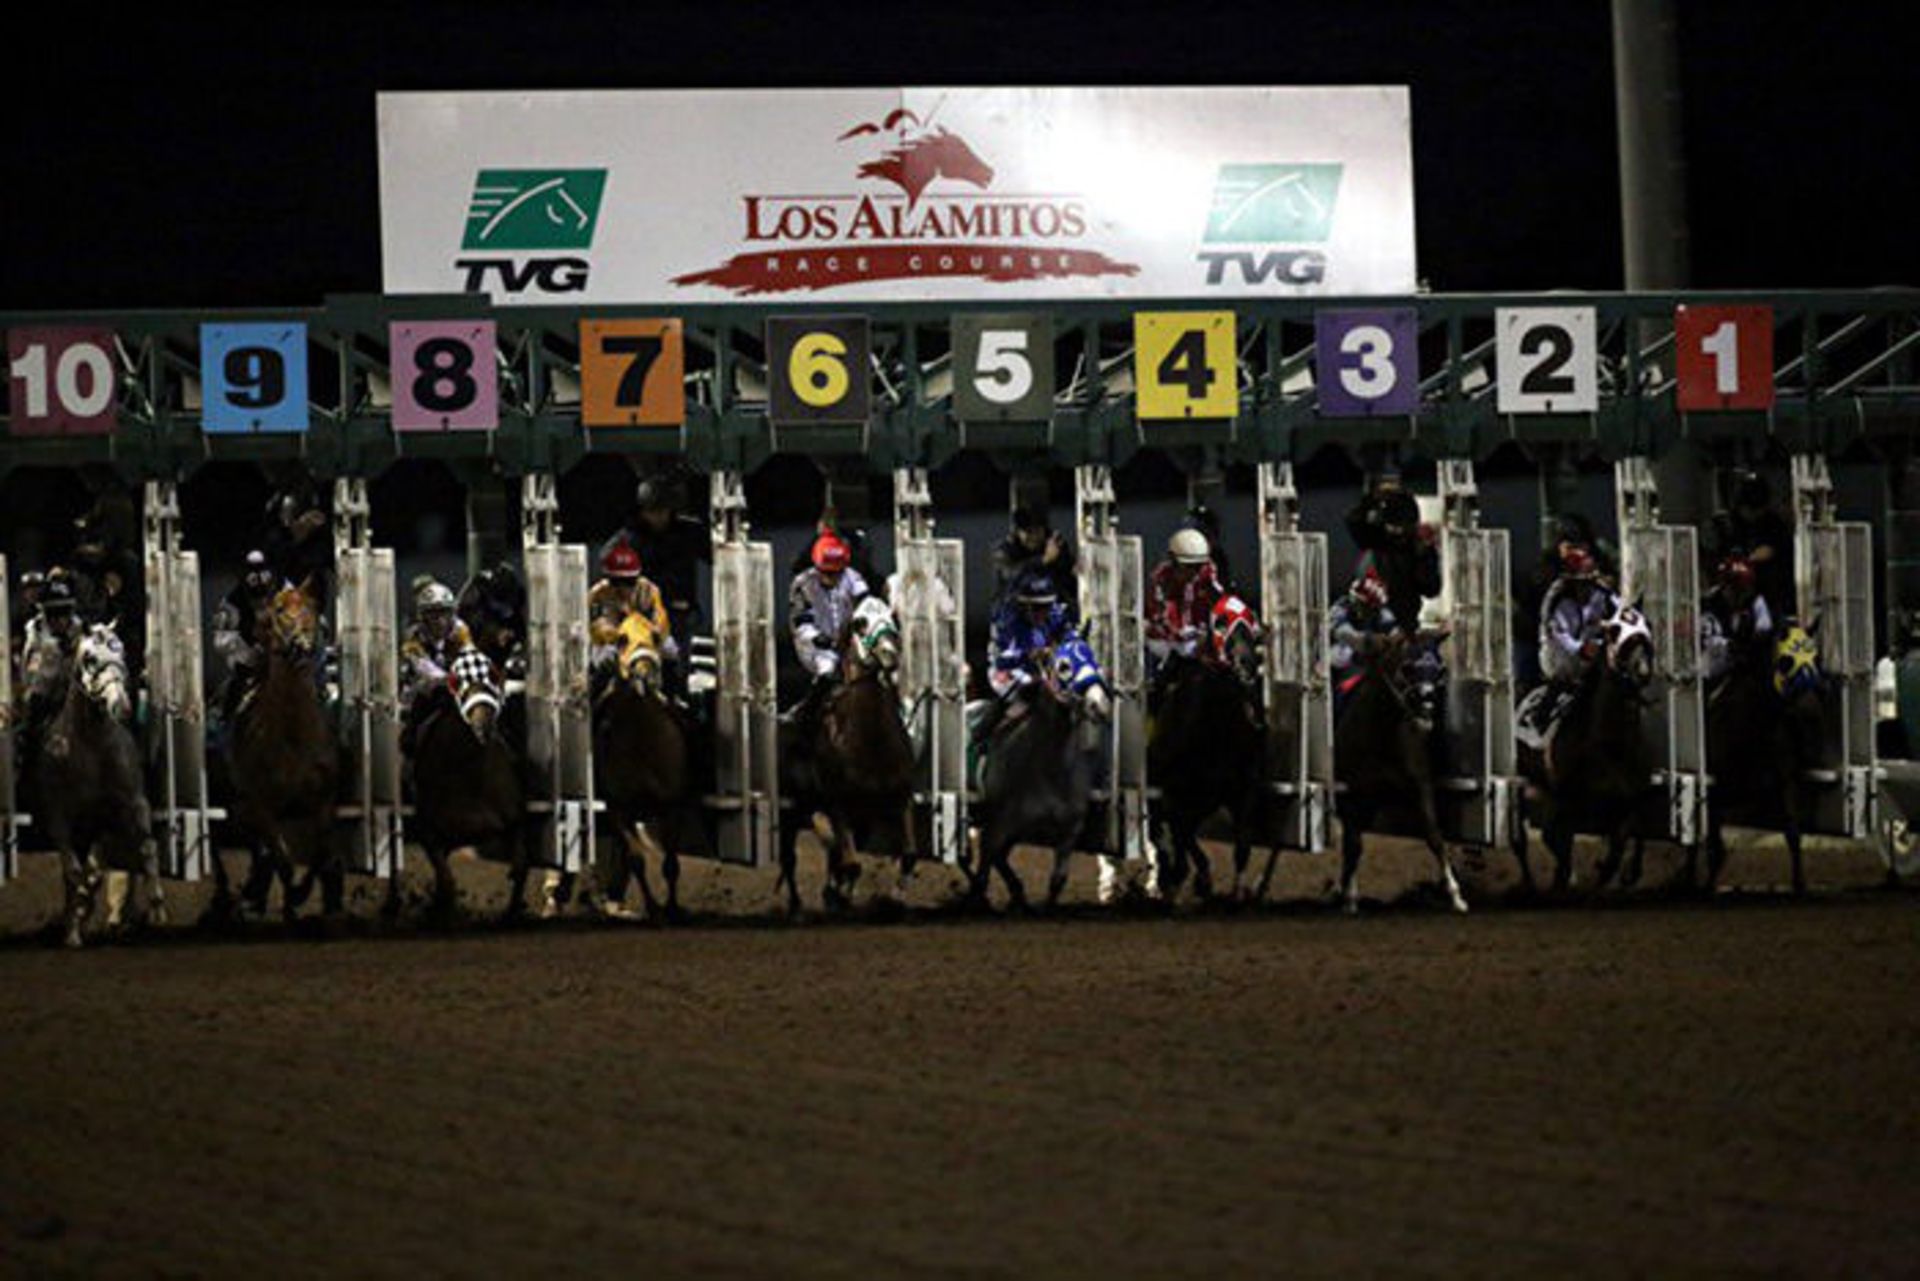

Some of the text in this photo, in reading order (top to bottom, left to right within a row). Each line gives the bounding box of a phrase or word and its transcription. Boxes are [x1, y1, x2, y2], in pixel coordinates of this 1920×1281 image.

[744, 194, 1086, 240] LOS ALAMITOS
[455, 257, 590, 292] TVG
[767, 254, 1072, 272] RACE COURSE
[1197, 250, 1327, 285] TVG
[10, 341, 115, 419] 10
[224, 347, 284, 408] 9
[414, 338, 476, 412] 8
[603, 337, 662, 407] 7
[788, 331, 850, 408] 6
[972, 330, 1033, 403] 5
[1158, 330, 1215, 399] 4
[1339, 325, 1397, 399] 3
[1519, 324, 1573, 394] 2
[1702, 320, 1739, 394] 1
